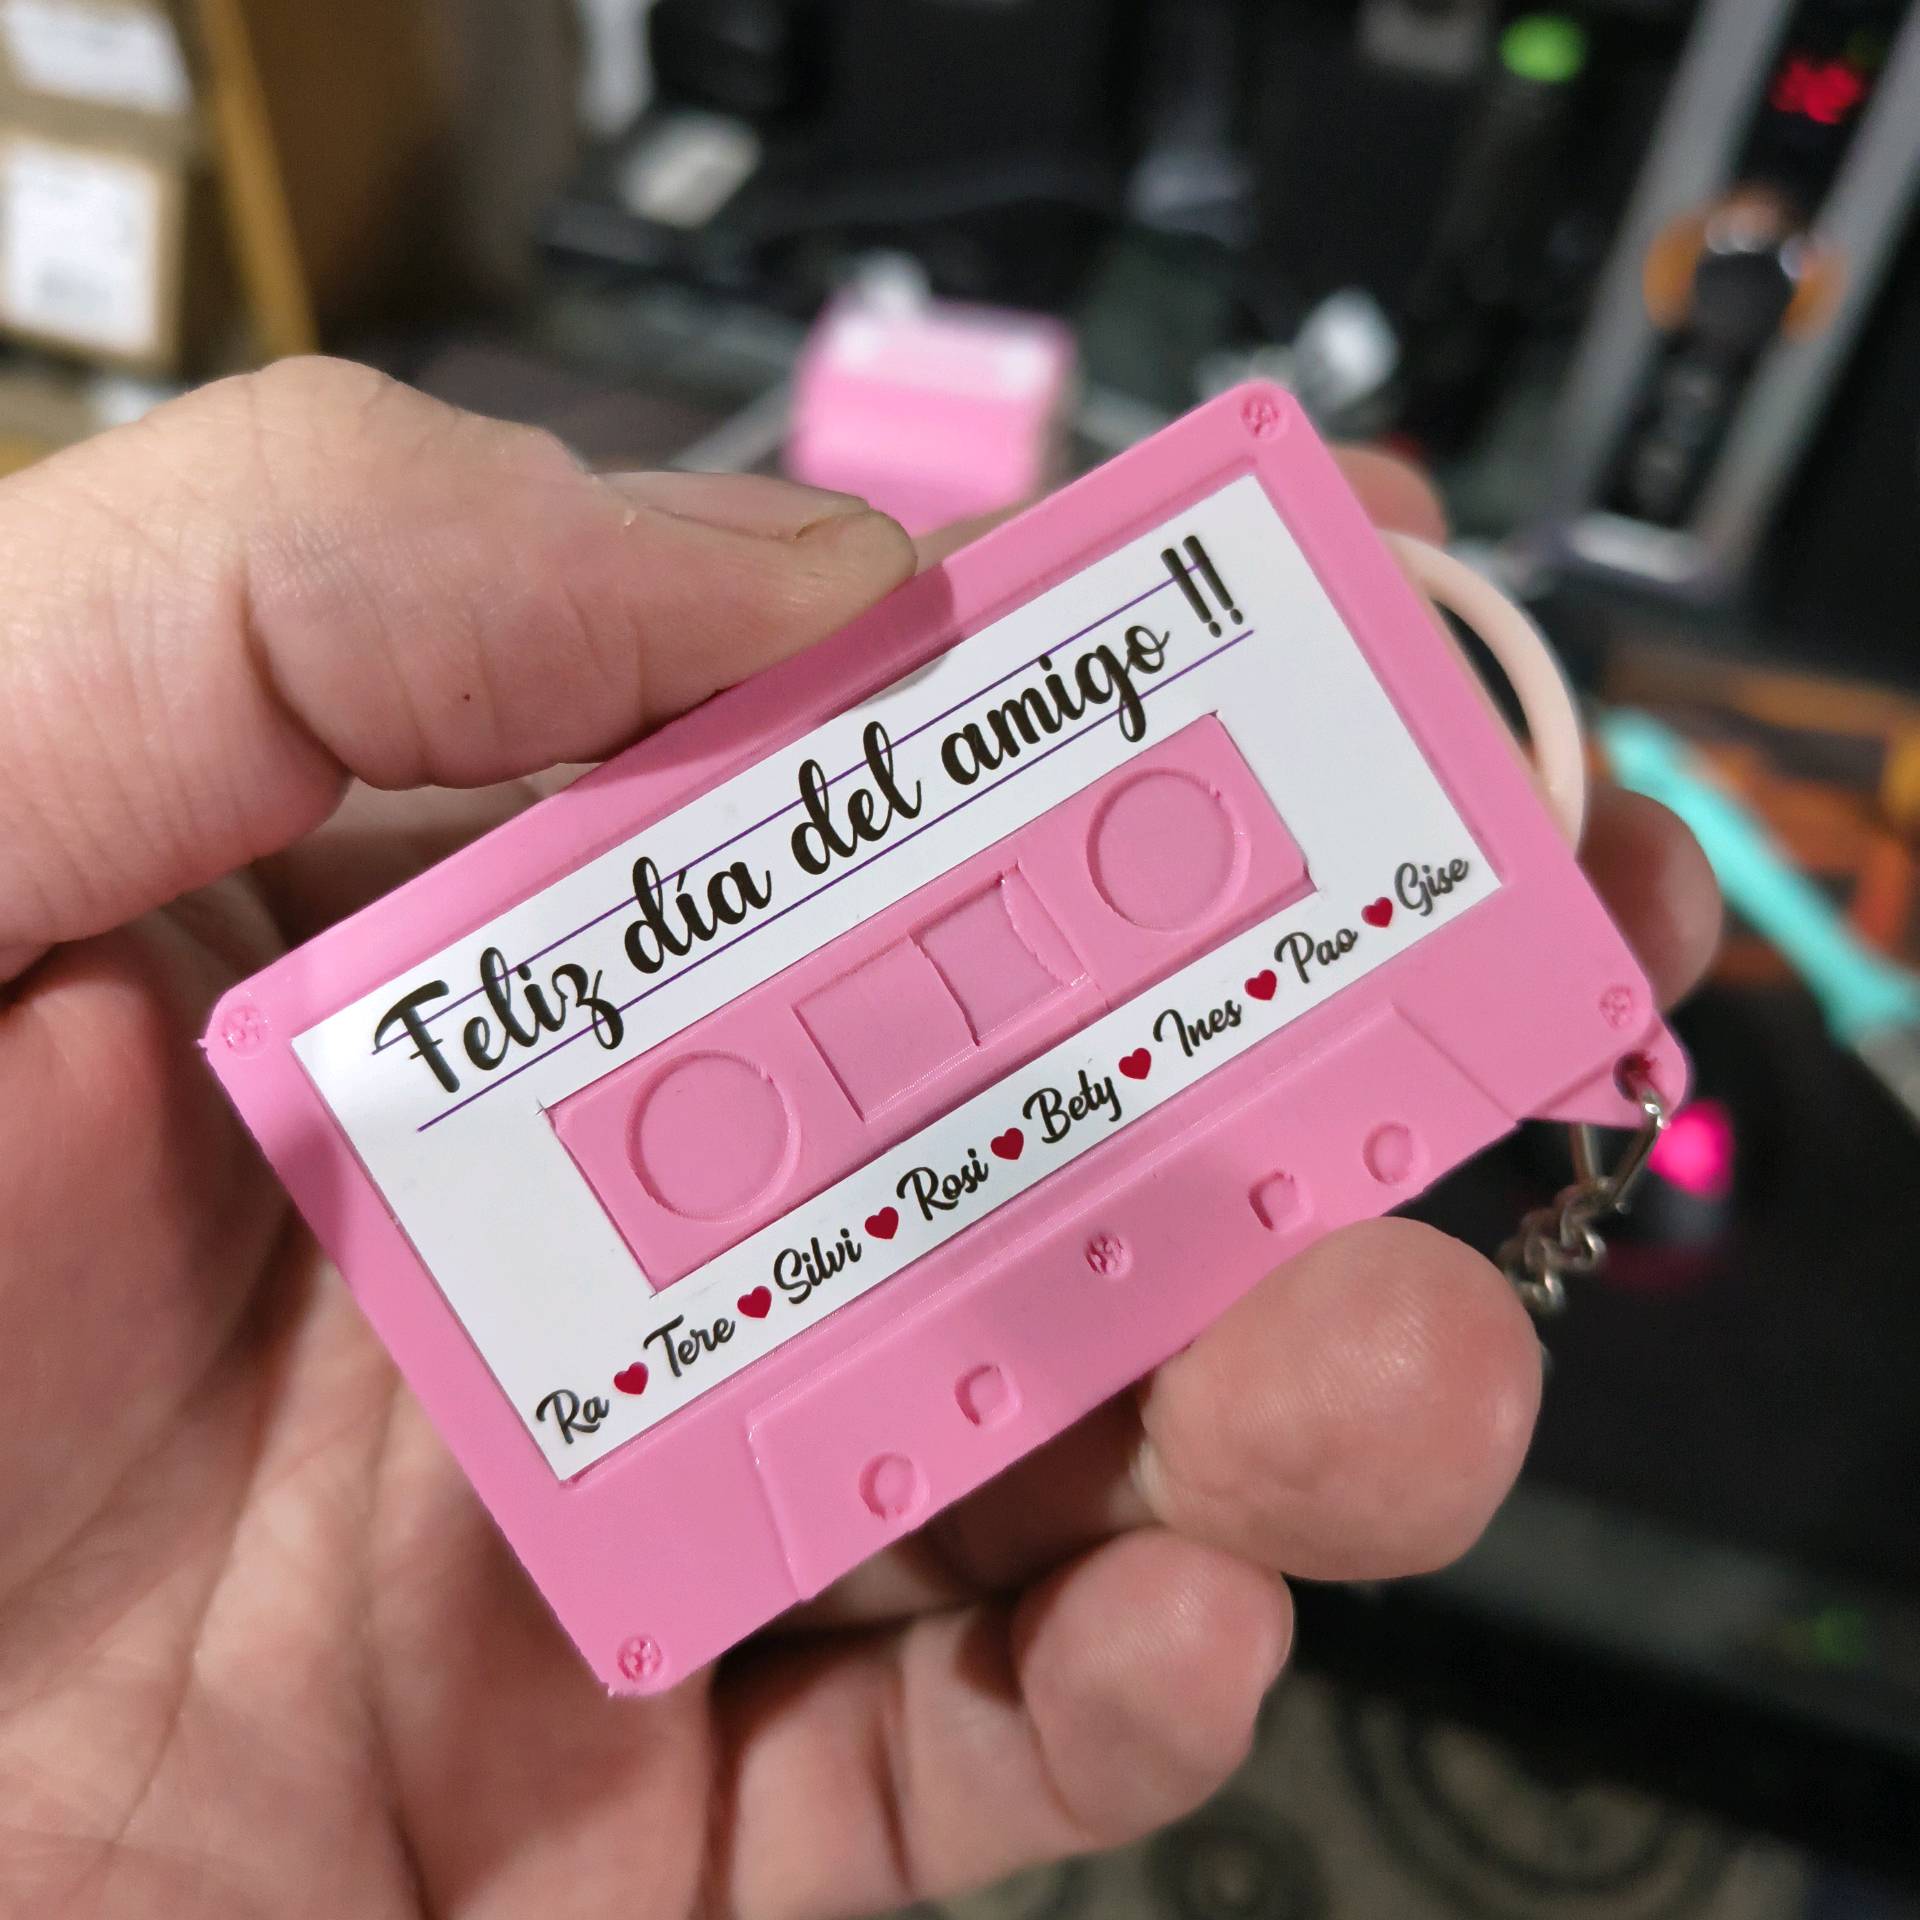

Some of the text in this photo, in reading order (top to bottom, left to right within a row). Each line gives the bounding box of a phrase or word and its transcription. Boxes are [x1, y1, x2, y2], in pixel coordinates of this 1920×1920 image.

[373, 946, 625, 1093] Feliz
[624, 856, 772, 975] día
[791, 720, 922, 875] del
[940, 625, 1170, 785] amigo
[536, 858, 1469, 1445] Ra Tere Silvi Rosi Bety Ines Pao Gise
